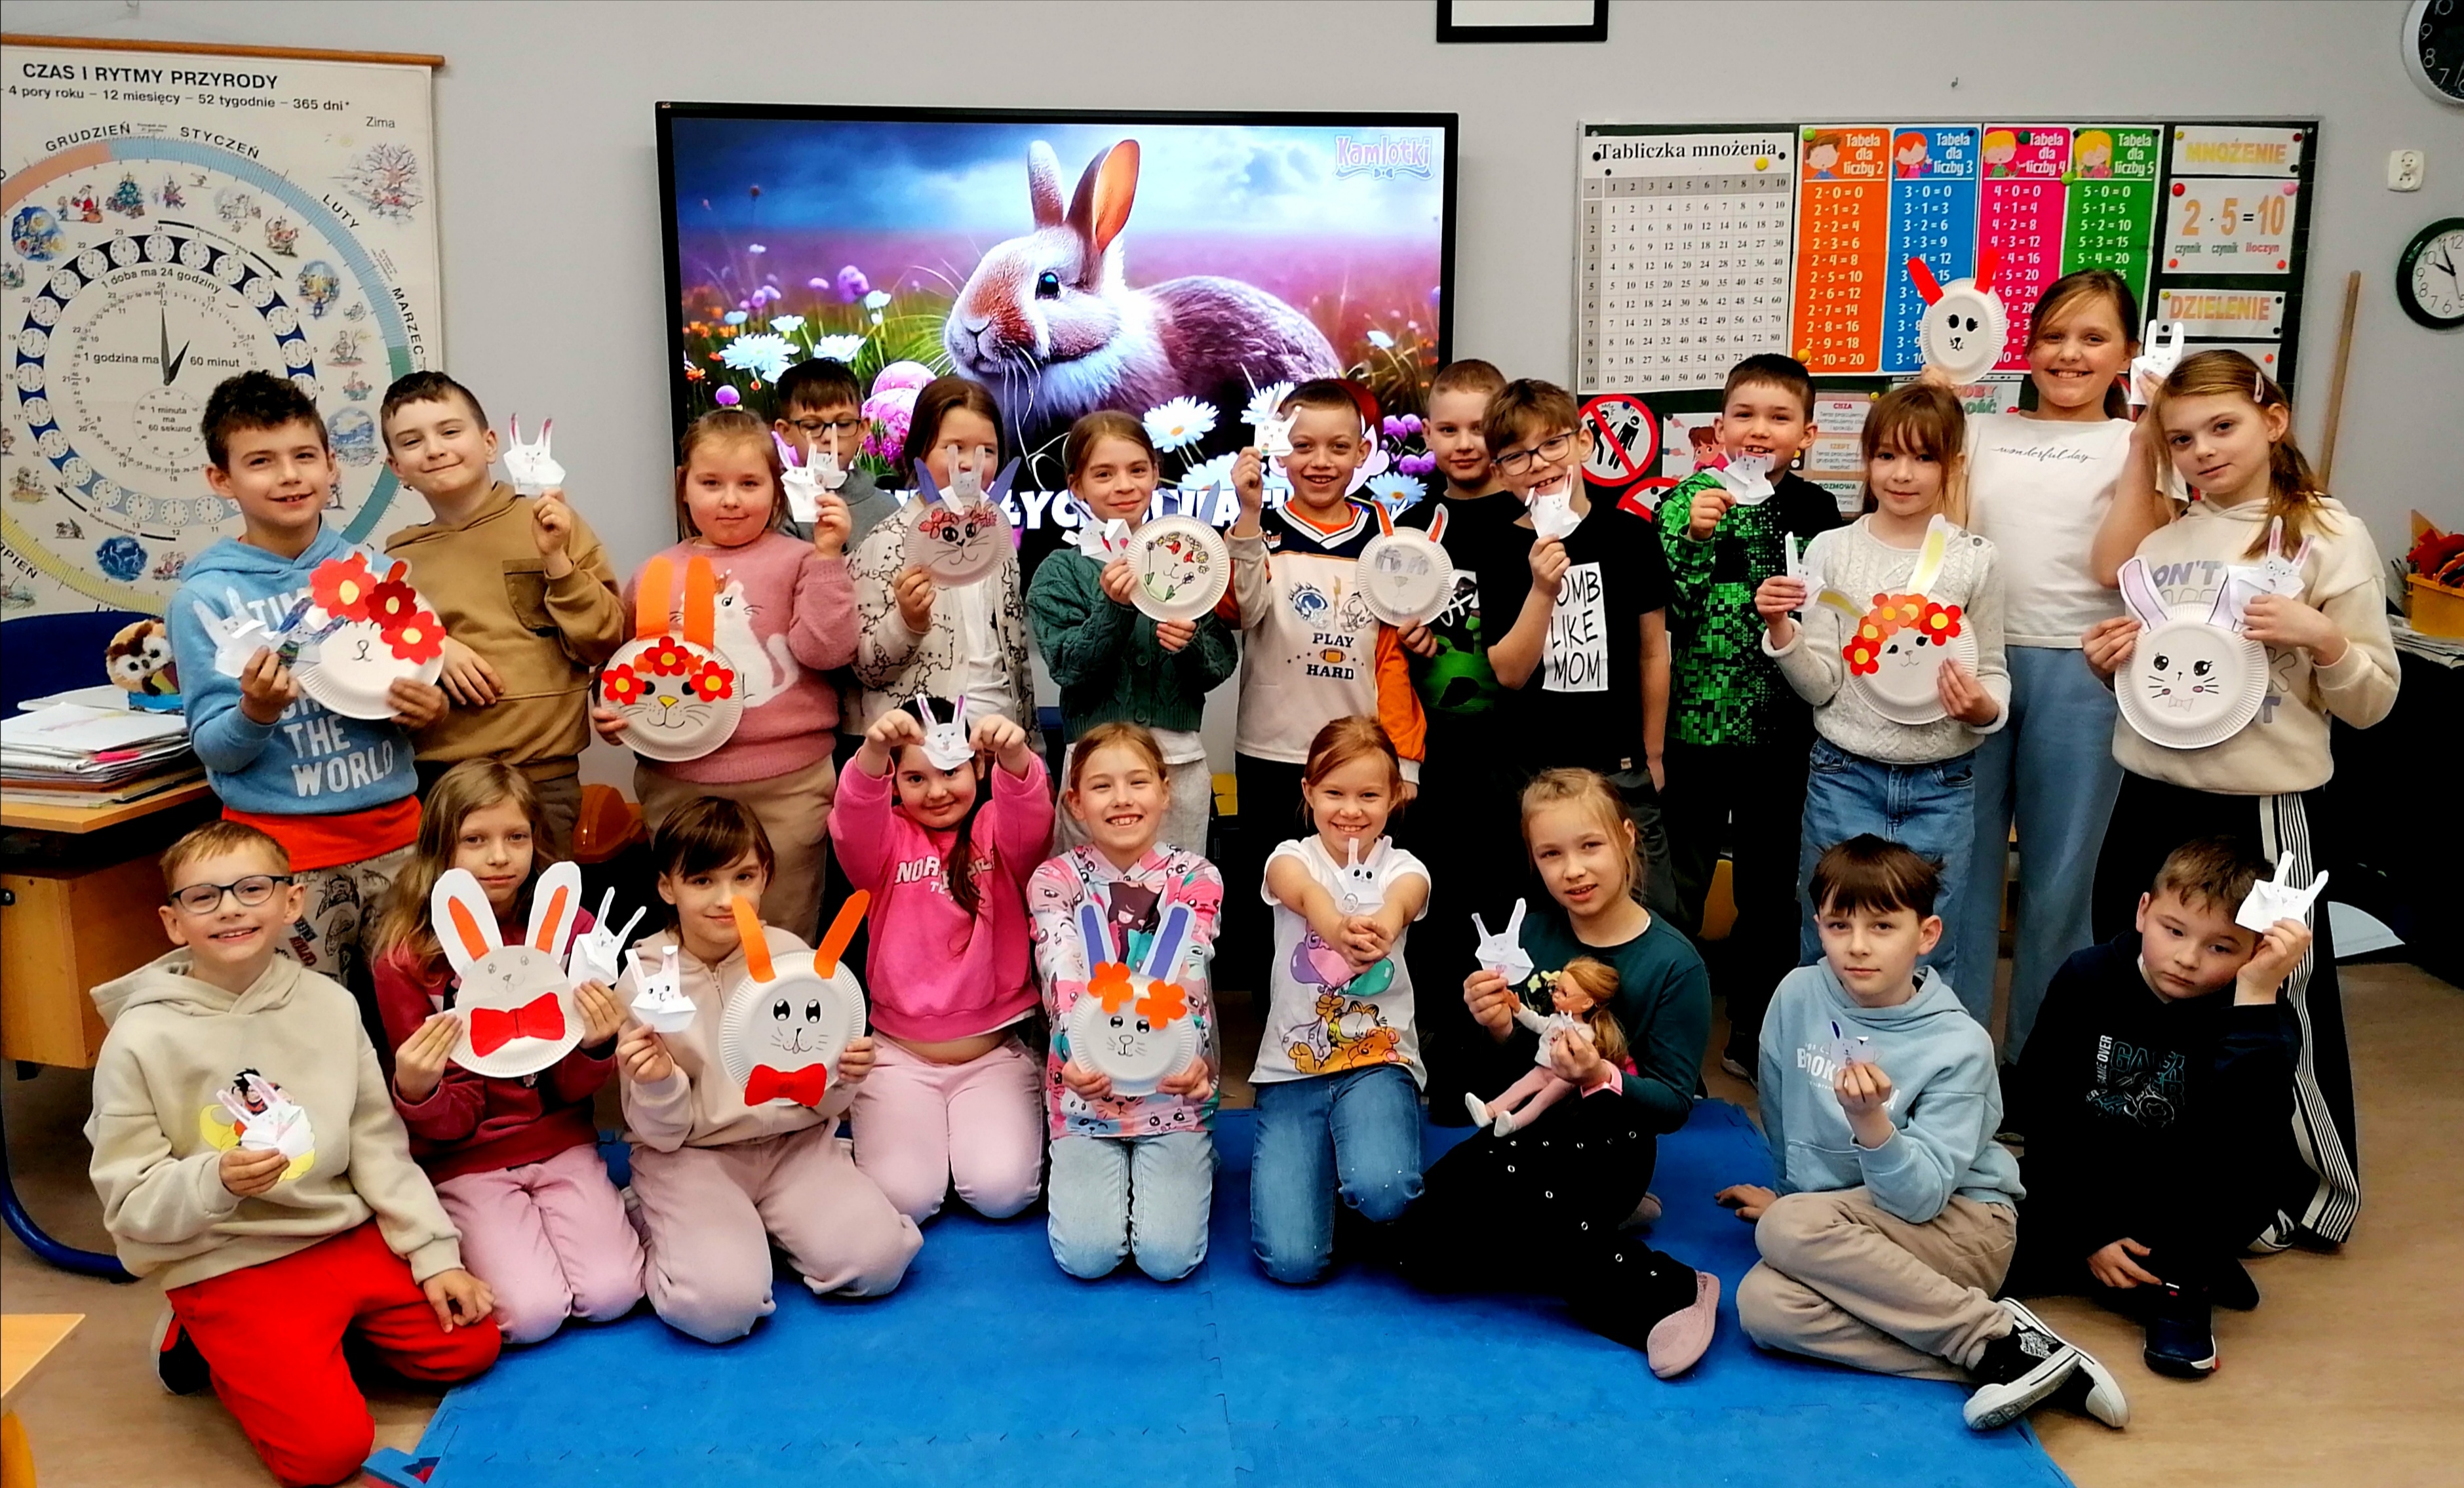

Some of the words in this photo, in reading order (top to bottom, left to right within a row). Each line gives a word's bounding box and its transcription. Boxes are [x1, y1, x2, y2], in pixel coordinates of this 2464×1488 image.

[23, 63, 75, 80] CZAS
[82, 66, 87, 81] I
[95, 67, 163, 84] RYTMY
[171, 70, 277, 89] PRZYRODY
[9, 85, 17, 95] 4
[22, 88, 51, 100] pory
[55, 88, 84, 98] roku
[104, 89, 119, 100] 12
[123, 90, 180, 106] miesięcy
[199, 94, 214, 104] 52
[219, 95, 275, 108] tygodnie
[293, 98, 319, 110] 365
[366, 116, 395, 128] Zima
[45, 121, 131, 153] GRUDZIEŃ
[180, 126, 260, 159] STYCZEŃ
[1845, 133, 1881, 147] Tabela
[1936, 130, 1971, 146] Tabela
[2028, 132, 2063, 146] Tabela
[2118, 133, 2152, 147] Tabela
[1335, 136, 1432, 168] Kamlotki
[1597, 142, 1685, 161] Tabliczka
[1692, 139, 1776, 157] mnożenia
[1855, 147, 1873, 161] dla
[1946, 146, 1963, 160] dla
[2038, 146, 2056, 160] dla
[2127, 147, 2144, 161] dla
[2184, 136, 2288, 166] MNOŻENIE
[1843, 159, 1875, 176] liczby
[1877, 161, 1884, 174] 2
[1933, 159, 1964, 176] liczby
[1966, 159, 1973, 174] 3
[2024, 159, 2057, 176] liczby
[2058, 160, 2067, 174] 4
[2114, 159, 2145, 177] liczby
[2147, 161, 2155, 174] 5
[1630, 182, 1635, 191] 2
[1649, 182, 1654, 191] 3
[1686, 181, 1691, 189] 5
[1723, 180, 1728, 188] 7
[1776, 178, 1786, 187] 10
[1815, 187, 1822, 199] 2
[1832, 186, 1841, 199] 0
[1854, 186, 1864, 199] 0
[323, 194, 360, 229] LUTY
[1814, 204, 1822, 216] 2
[1832, 203, 1839, 216] 1
[1852, 203, 1859, 215] 2
[2181, 199, 2201, 236] 2
[2221, 197, 2238, 236] 5
[2258, 192, 2287, 236] 10
[1813, 221, 1821, 233] 2
[1831, 220, 1839, 233] 2
[1852, 220, 1860, 232] 4
[2174, 242, 2202, 256] czynnik
[2212, 242, 2239, 256] czynnik
[2245, 242, 2280, 254] iloczyn
[2450, 234, 2464, 250] 12
[111, 271, 138, 285] doba
[161, 267, 173, 277] 24
[177, 270, 222, 295] godziny
[2414, 266, 2426, 281] 9
[1589, 282, 1594, 290] 5
[1610, 281, 1615, 290] 5
[1645, 281, 1654, 289] 15
[1662, 280, 1673, 288] 20
[1681, 279, 1691, 288] 25
[1699, 279, 1710, 288] 30
[1717, 279, 1727, 287] 35
[1772, 277, 1782, 285] 50
[2418, 281, 2429, 298] 8
[2168, 293, 2271, 321] DZIELENIE
[2429, 295, 2439, 309] 7
[2442, 300, 2452, 315] 6
[392, 287, 424, 355] MARZEC
[83, 352, 89, 361] 1
[93, 353, 138, 364] godzina
[142, 356, 159, 364] ma
[190, 356, 204, 366] 60
[207, 357, 240, 368] minut
[1551, 610, 1598, 650] LIKE
[1312, 633, 1354, 648] PLAY
[1306, 663, 1355, 680] HARD
[1554, 650, 1600, 689] MOM
[283, 715, 351, 758] THE
[291, 740, 393, 797] WORLD
